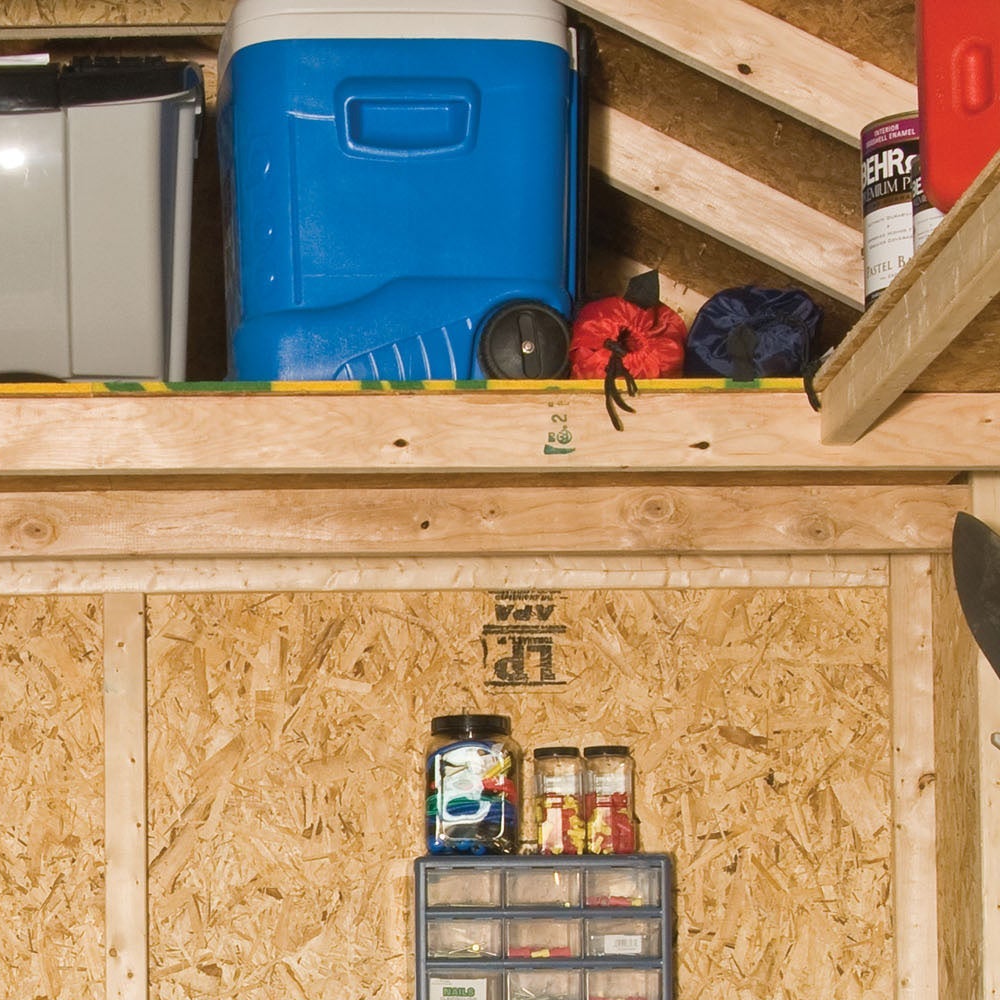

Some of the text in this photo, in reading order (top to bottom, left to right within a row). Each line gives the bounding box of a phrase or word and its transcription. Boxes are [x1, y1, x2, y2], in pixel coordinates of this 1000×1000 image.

[874, 123, 899, 137] INTERIOR
[888, 128, 916, 140] ENAMEL
[495, 604, 555, 621] APA
[494, 645, 556, 681] LP
[443, 987, 475, 997] NAILS
